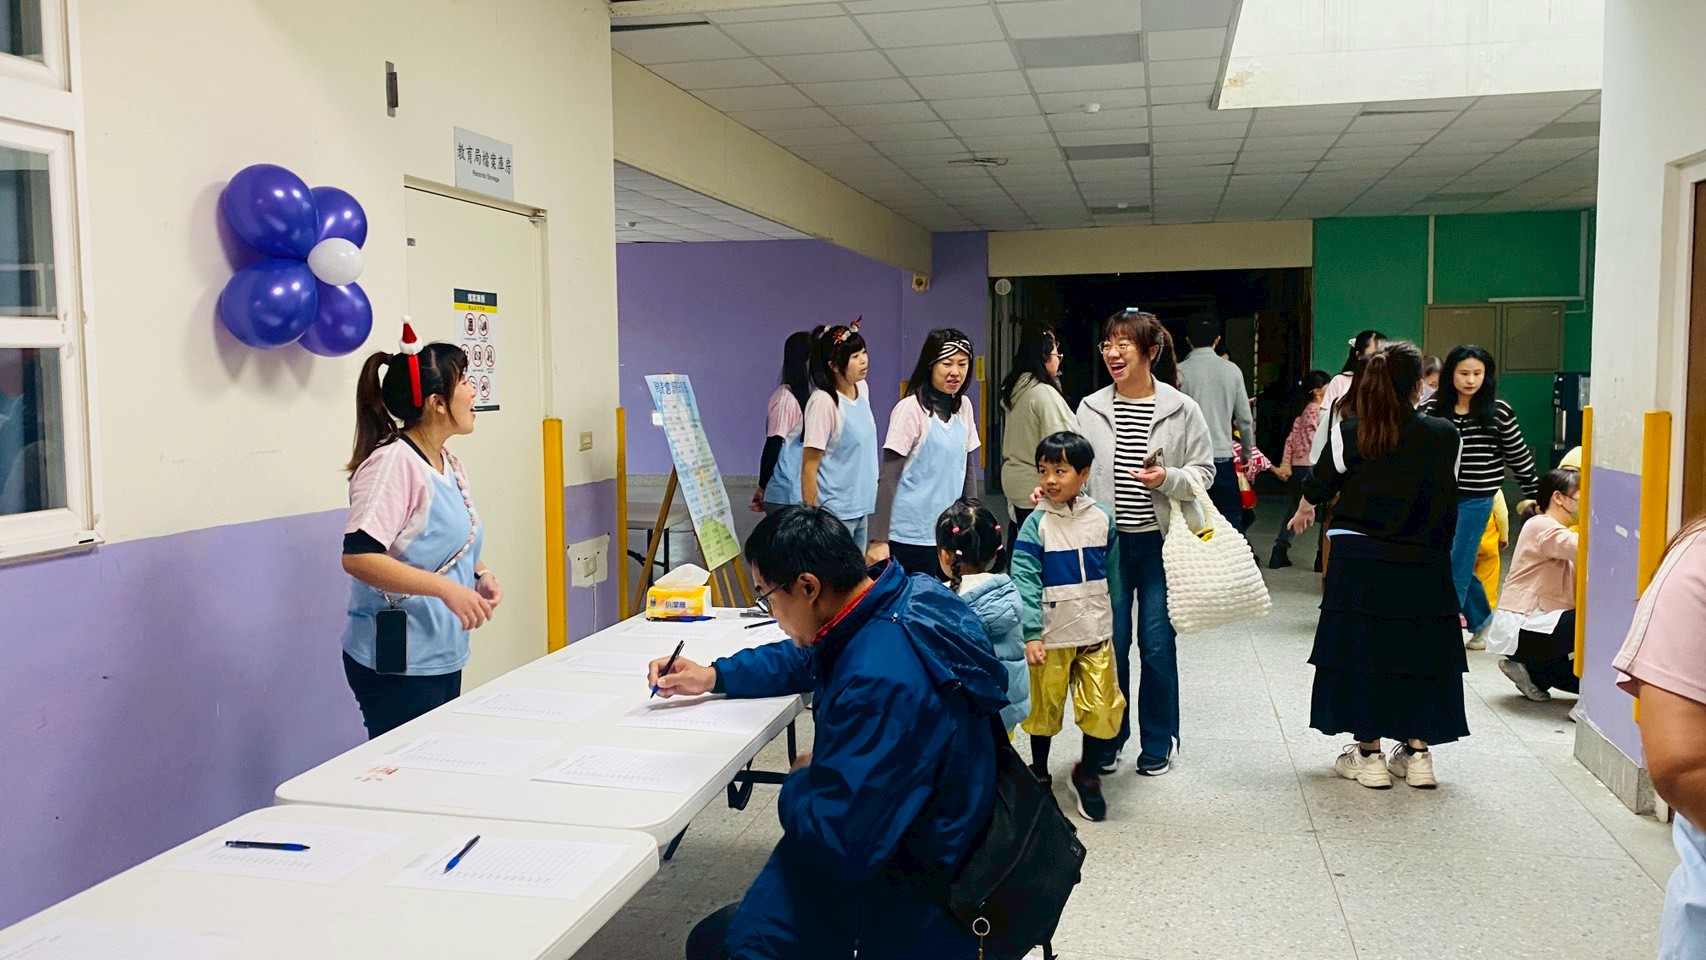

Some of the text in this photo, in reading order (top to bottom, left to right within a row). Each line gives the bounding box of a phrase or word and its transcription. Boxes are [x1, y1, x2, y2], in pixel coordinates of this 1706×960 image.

[457, 142, 512, 175] 教育局檔案庫房
